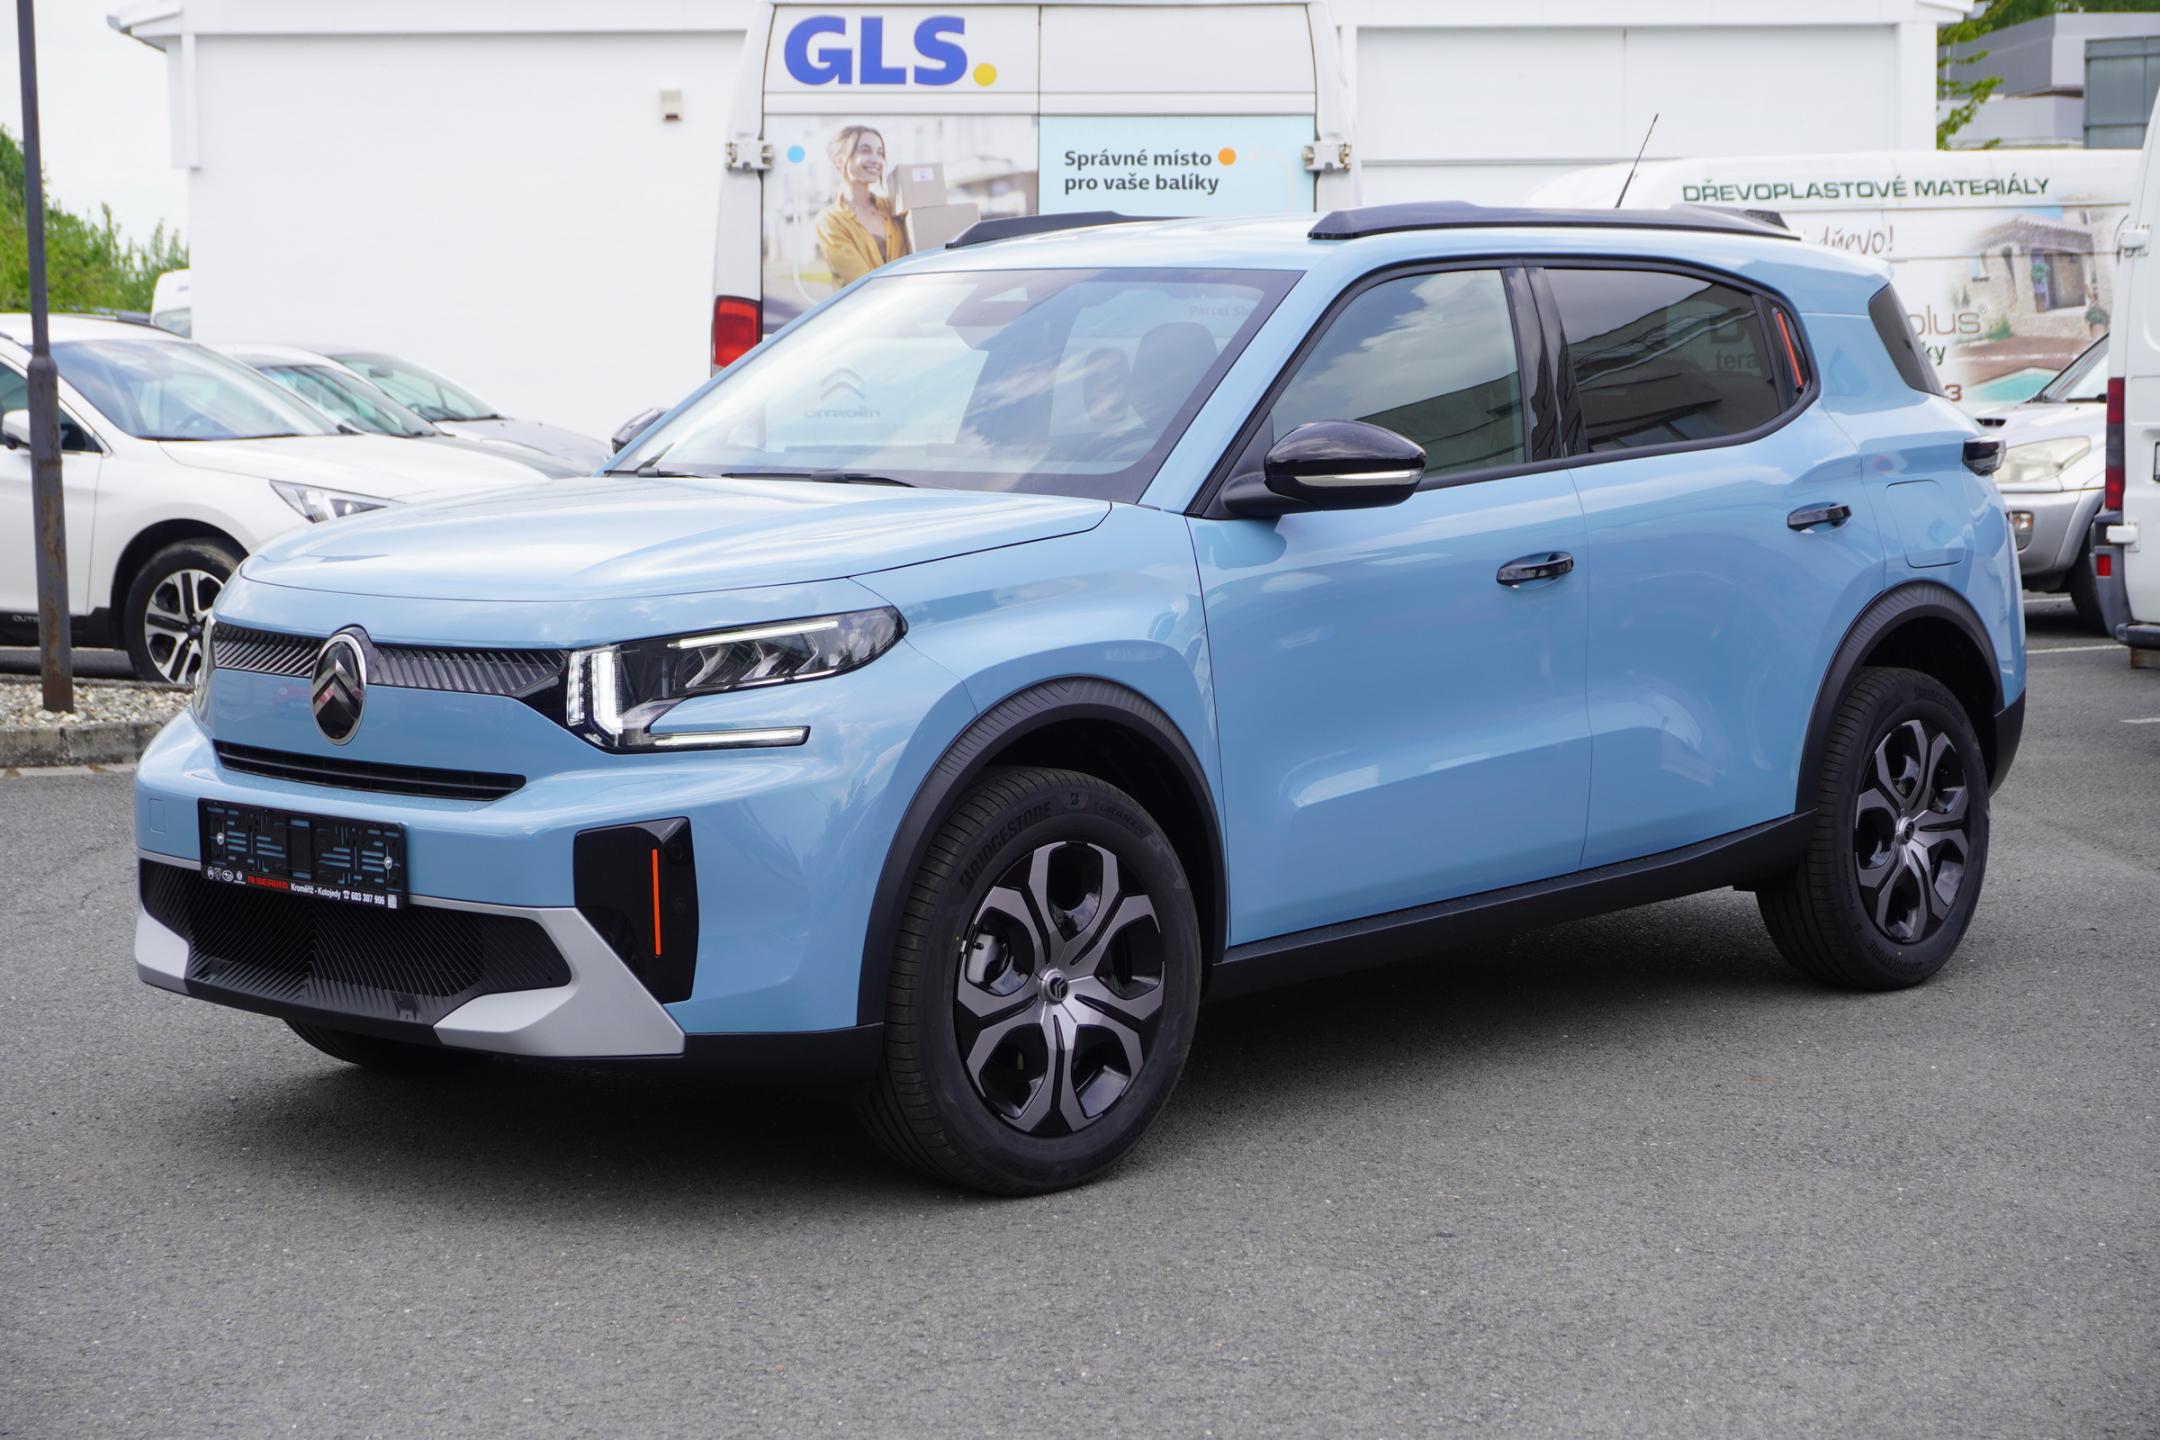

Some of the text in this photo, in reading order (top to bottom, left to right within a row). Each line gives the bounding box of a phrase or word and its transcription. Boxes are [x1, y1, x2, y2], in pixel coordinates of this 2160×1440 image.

[1064, 149, 1212, 171] Správné místo
[1064, 173, 1219, 195] pro vaše balíky
[1683, 172, 2049, 201] DŘEVOPLASTOVÉ MATERIÁLY
[959, 801, 1052, 891] BRIDGESTONE
